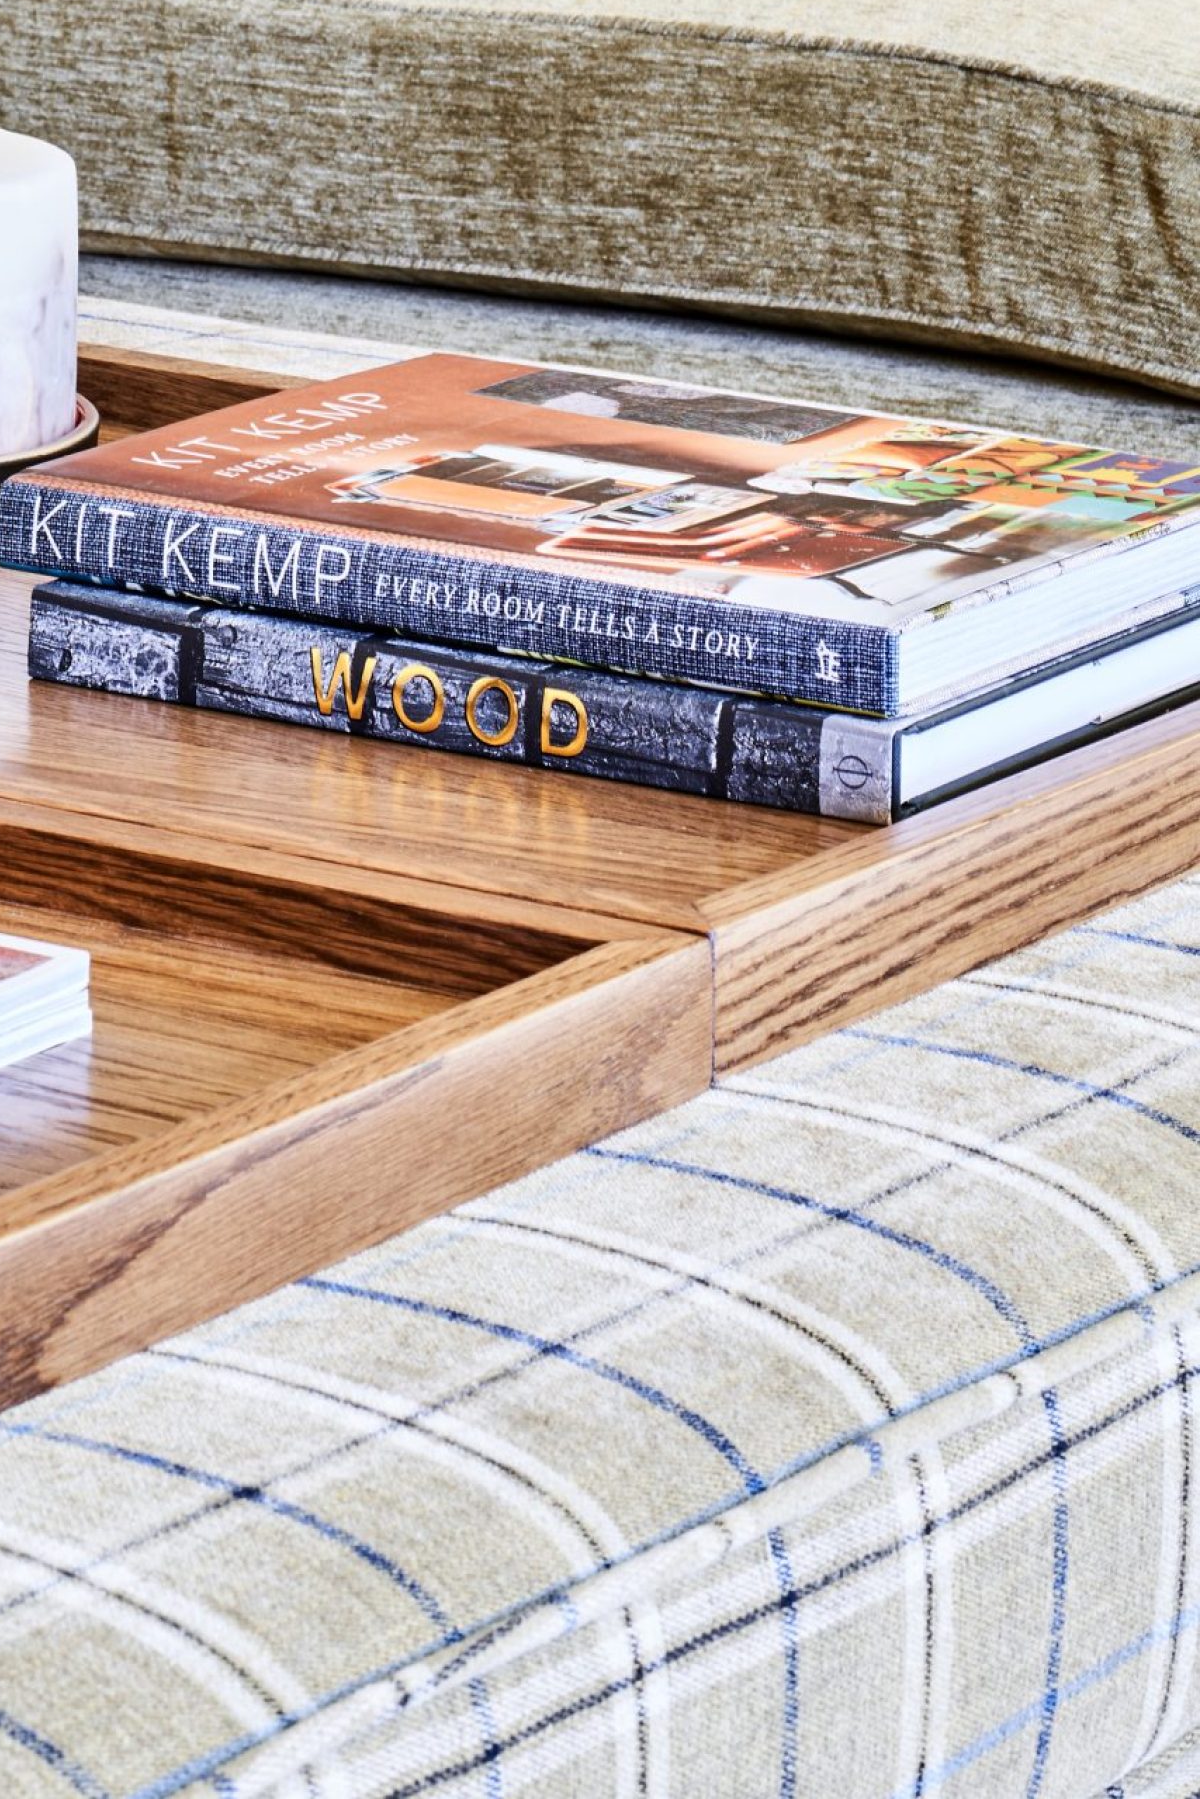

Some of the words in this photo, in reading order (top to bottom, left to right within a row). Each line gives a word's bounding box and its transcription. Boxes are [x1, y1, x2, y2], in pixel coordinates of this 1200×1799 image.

[131, 436, 240, 470] KIT
[230, 392, 388, 440] KEMP
[213, 452, 293, 479] EVERY
[288, 431, 366, 456] ROOM
[341, 433, 420, 457] STORY
[30, 494, 135, 569] KIT
[162, 517, 351, 605] KEMP
[375, 574, 455, 604] EVERY
[464, 585, 545, 623] ROOM
[556, 606, 634, 640] TELLS
[643, 619, 661, 644] A
[670, 623, 761, 661] STORY
[310, 647, 588, 757] WOOD
